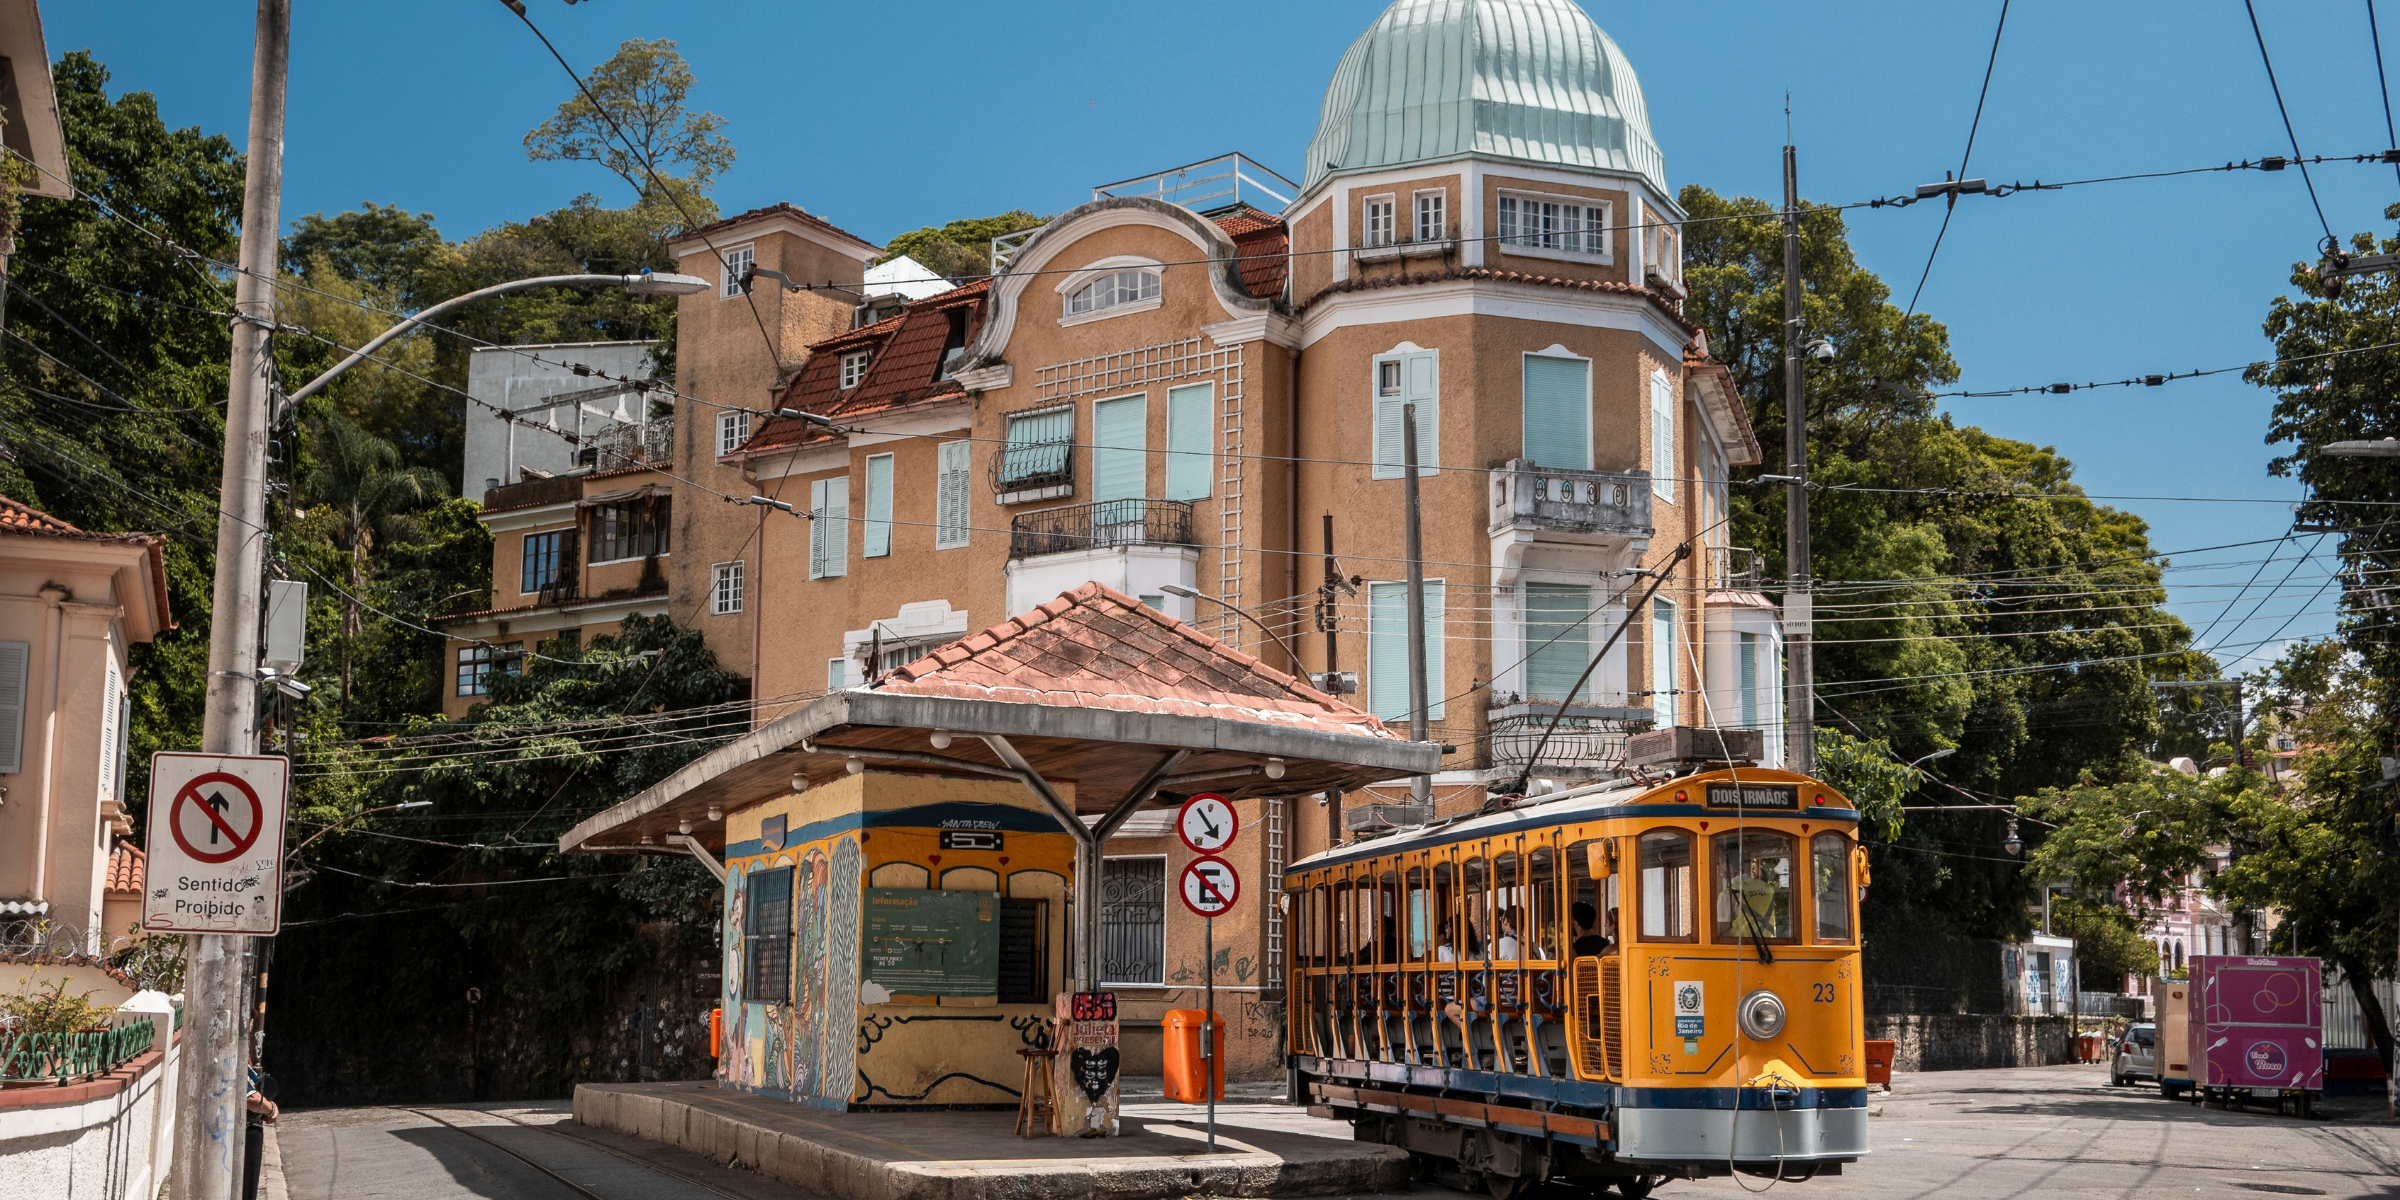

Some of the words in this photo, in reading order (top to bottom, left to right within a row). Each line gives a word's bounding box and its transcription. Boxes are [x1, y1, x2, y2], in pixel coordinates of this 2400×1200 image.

[1711, 789, 1739, 804] DOIS
[1743, 788, 1789, 805] IRMÃOS
[178, 876, 245, 892] Sentido
[175, 899, 245, 915] Proibido
[872, 897, 919, 907] Informação
[1812, 982, 1835, 1003] 23
[2254, 1059, 2283, 1070] Rosa
